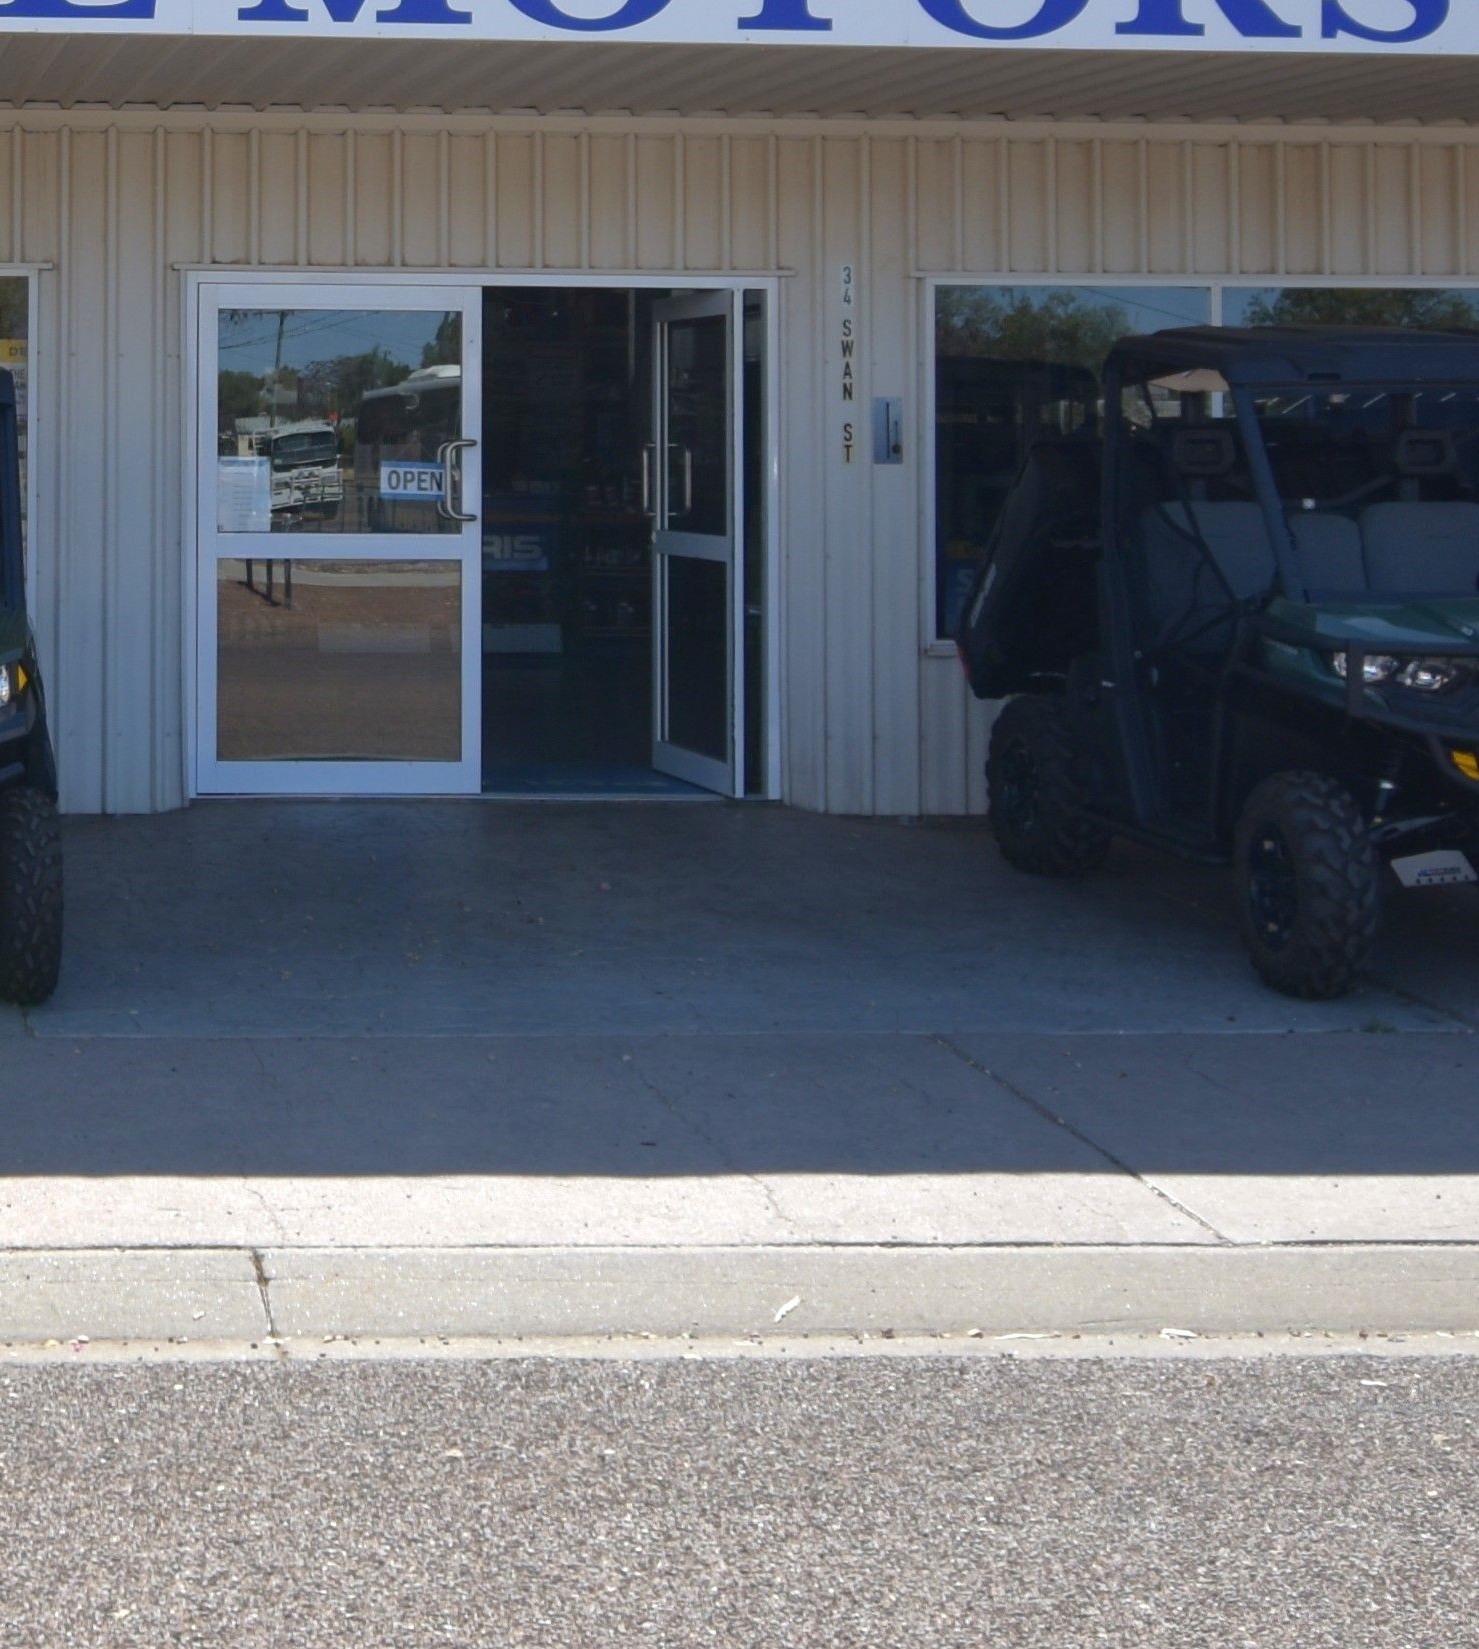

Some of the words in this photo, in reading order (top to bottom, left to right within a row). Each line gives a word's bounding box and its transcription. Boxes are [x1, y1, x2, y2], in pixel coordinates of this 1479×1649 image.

[841, 319, 854, 401] SWAN
[843, 423, 853, 463] ST
[387, 469, 443, 492] OPEN
